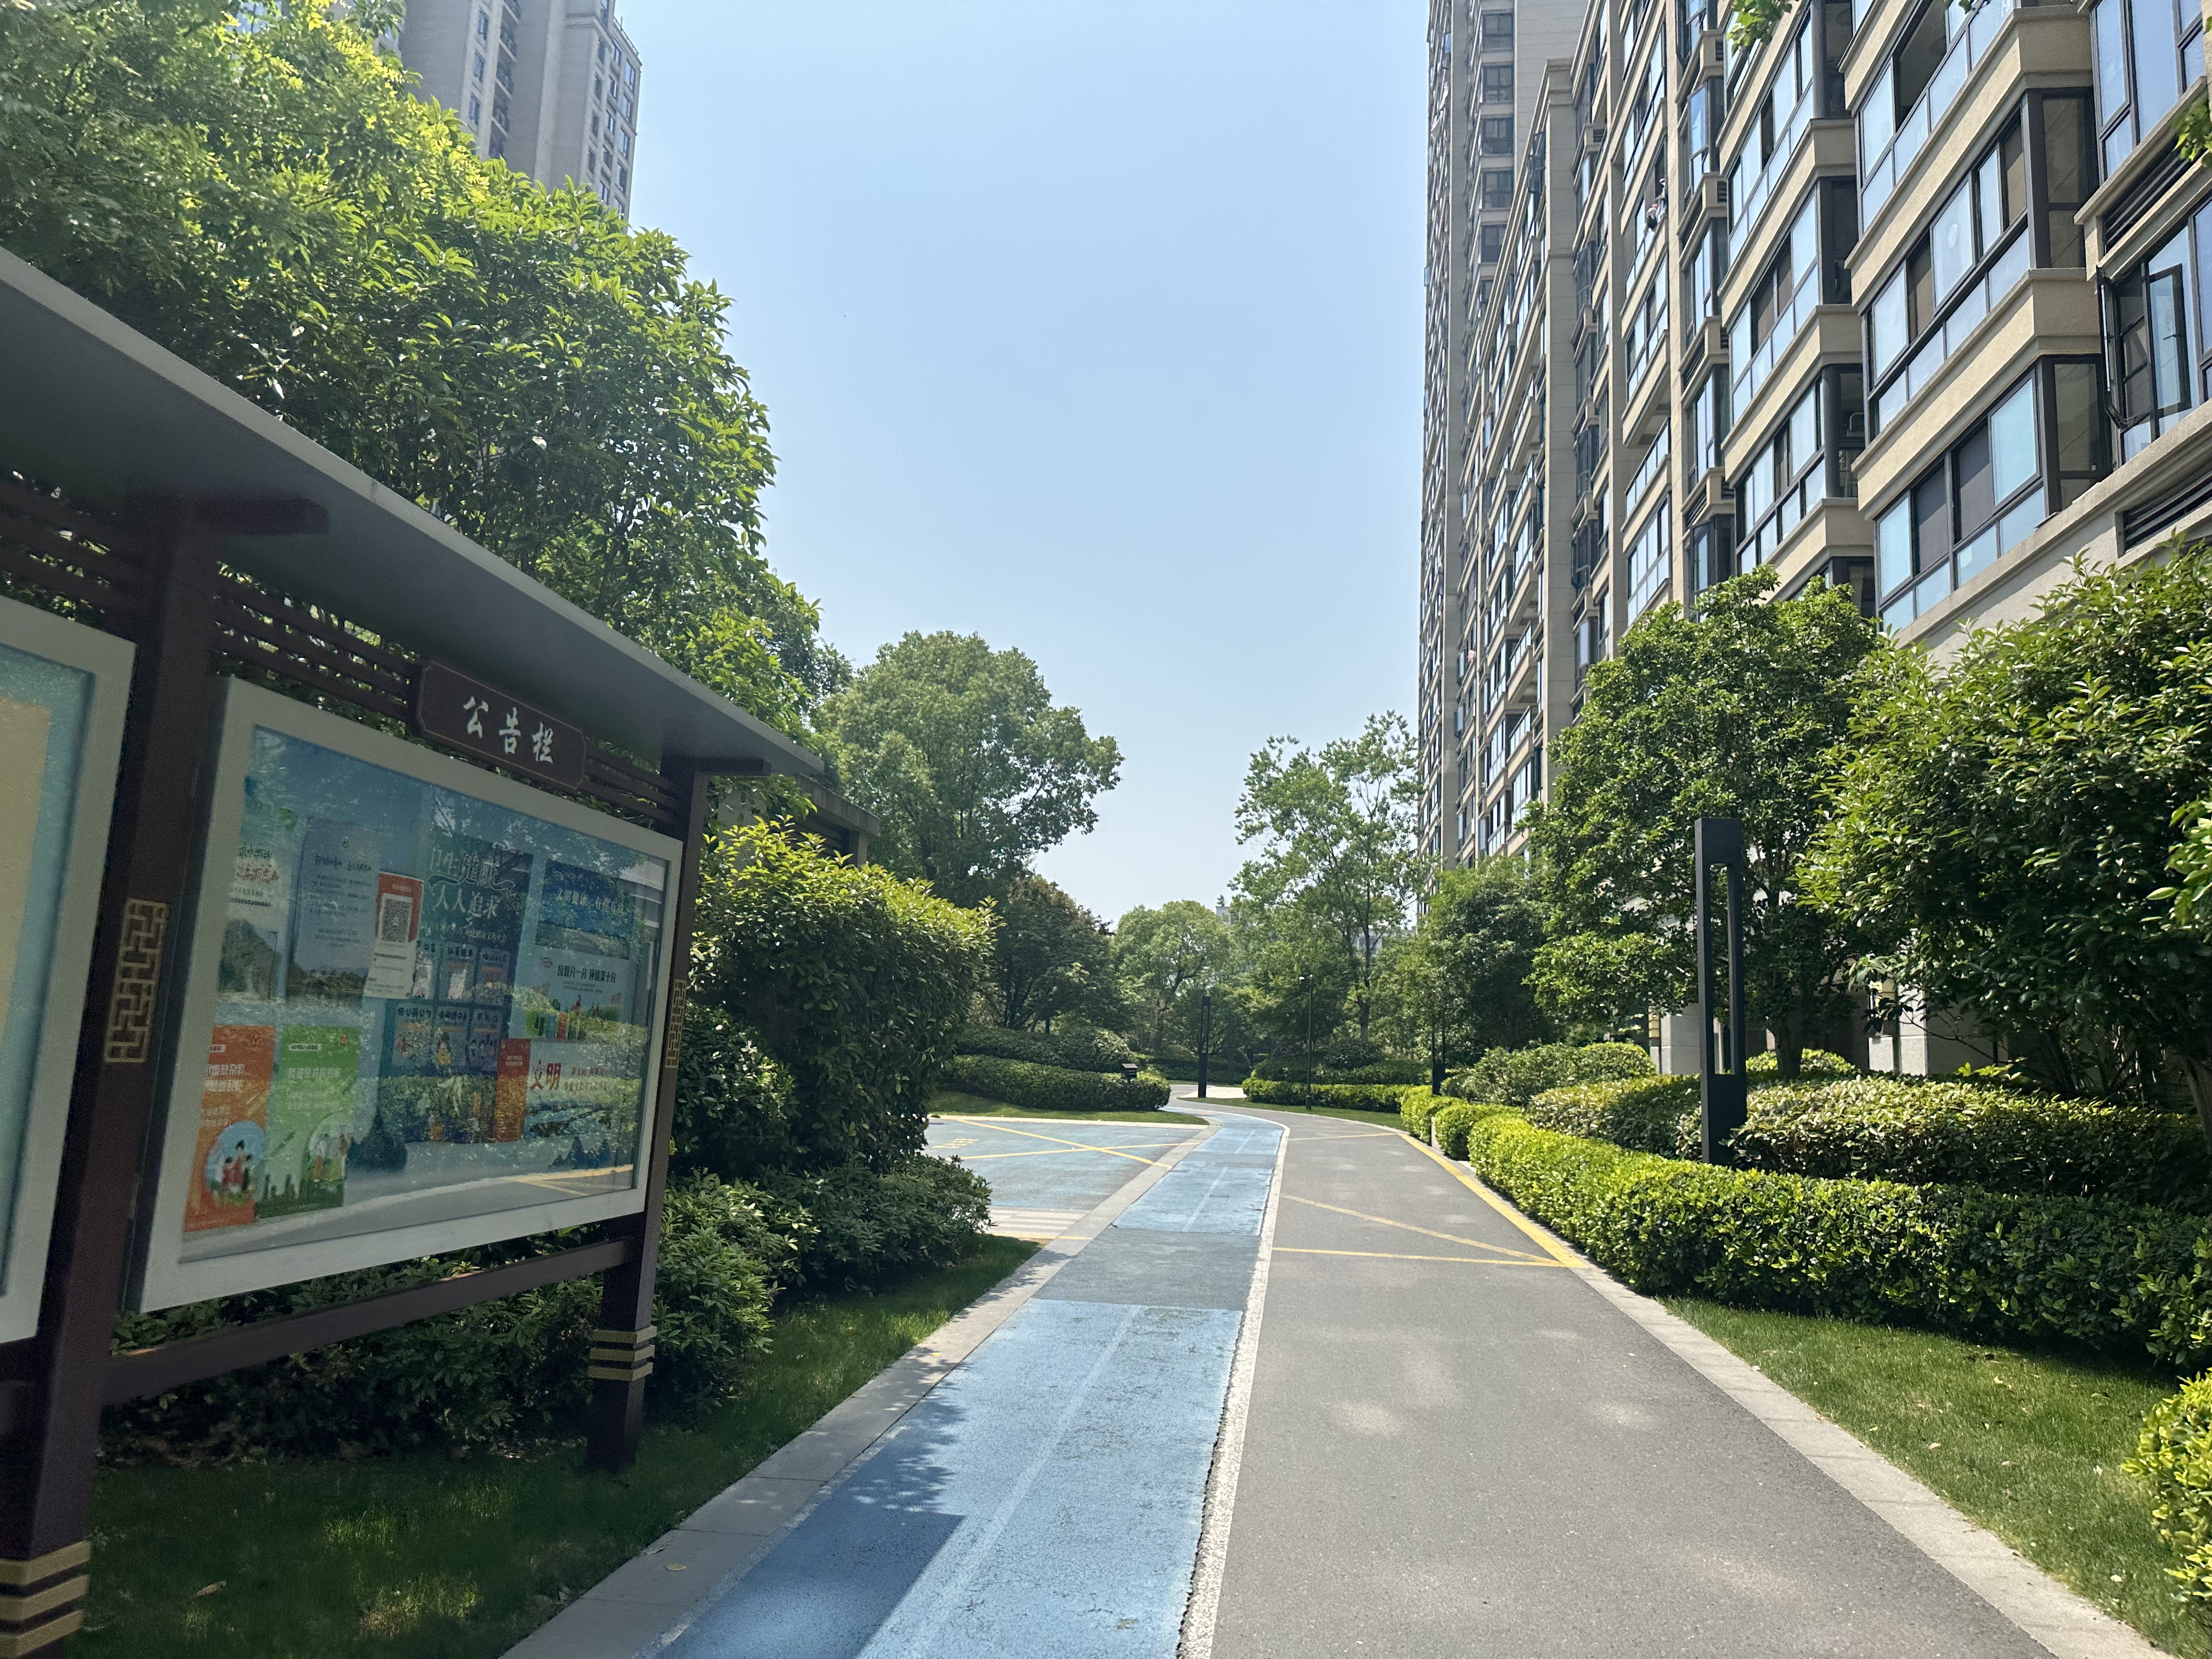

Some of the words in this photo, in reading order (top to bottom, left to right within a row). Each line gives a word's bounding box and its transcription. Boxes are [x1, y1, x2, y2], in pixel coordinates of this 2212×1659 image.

[432, 884, 501, 920] 人人追求
[557, 964, 587, 980] 垃圾分一分
[589, 968, 616, 984] 环境美十分
